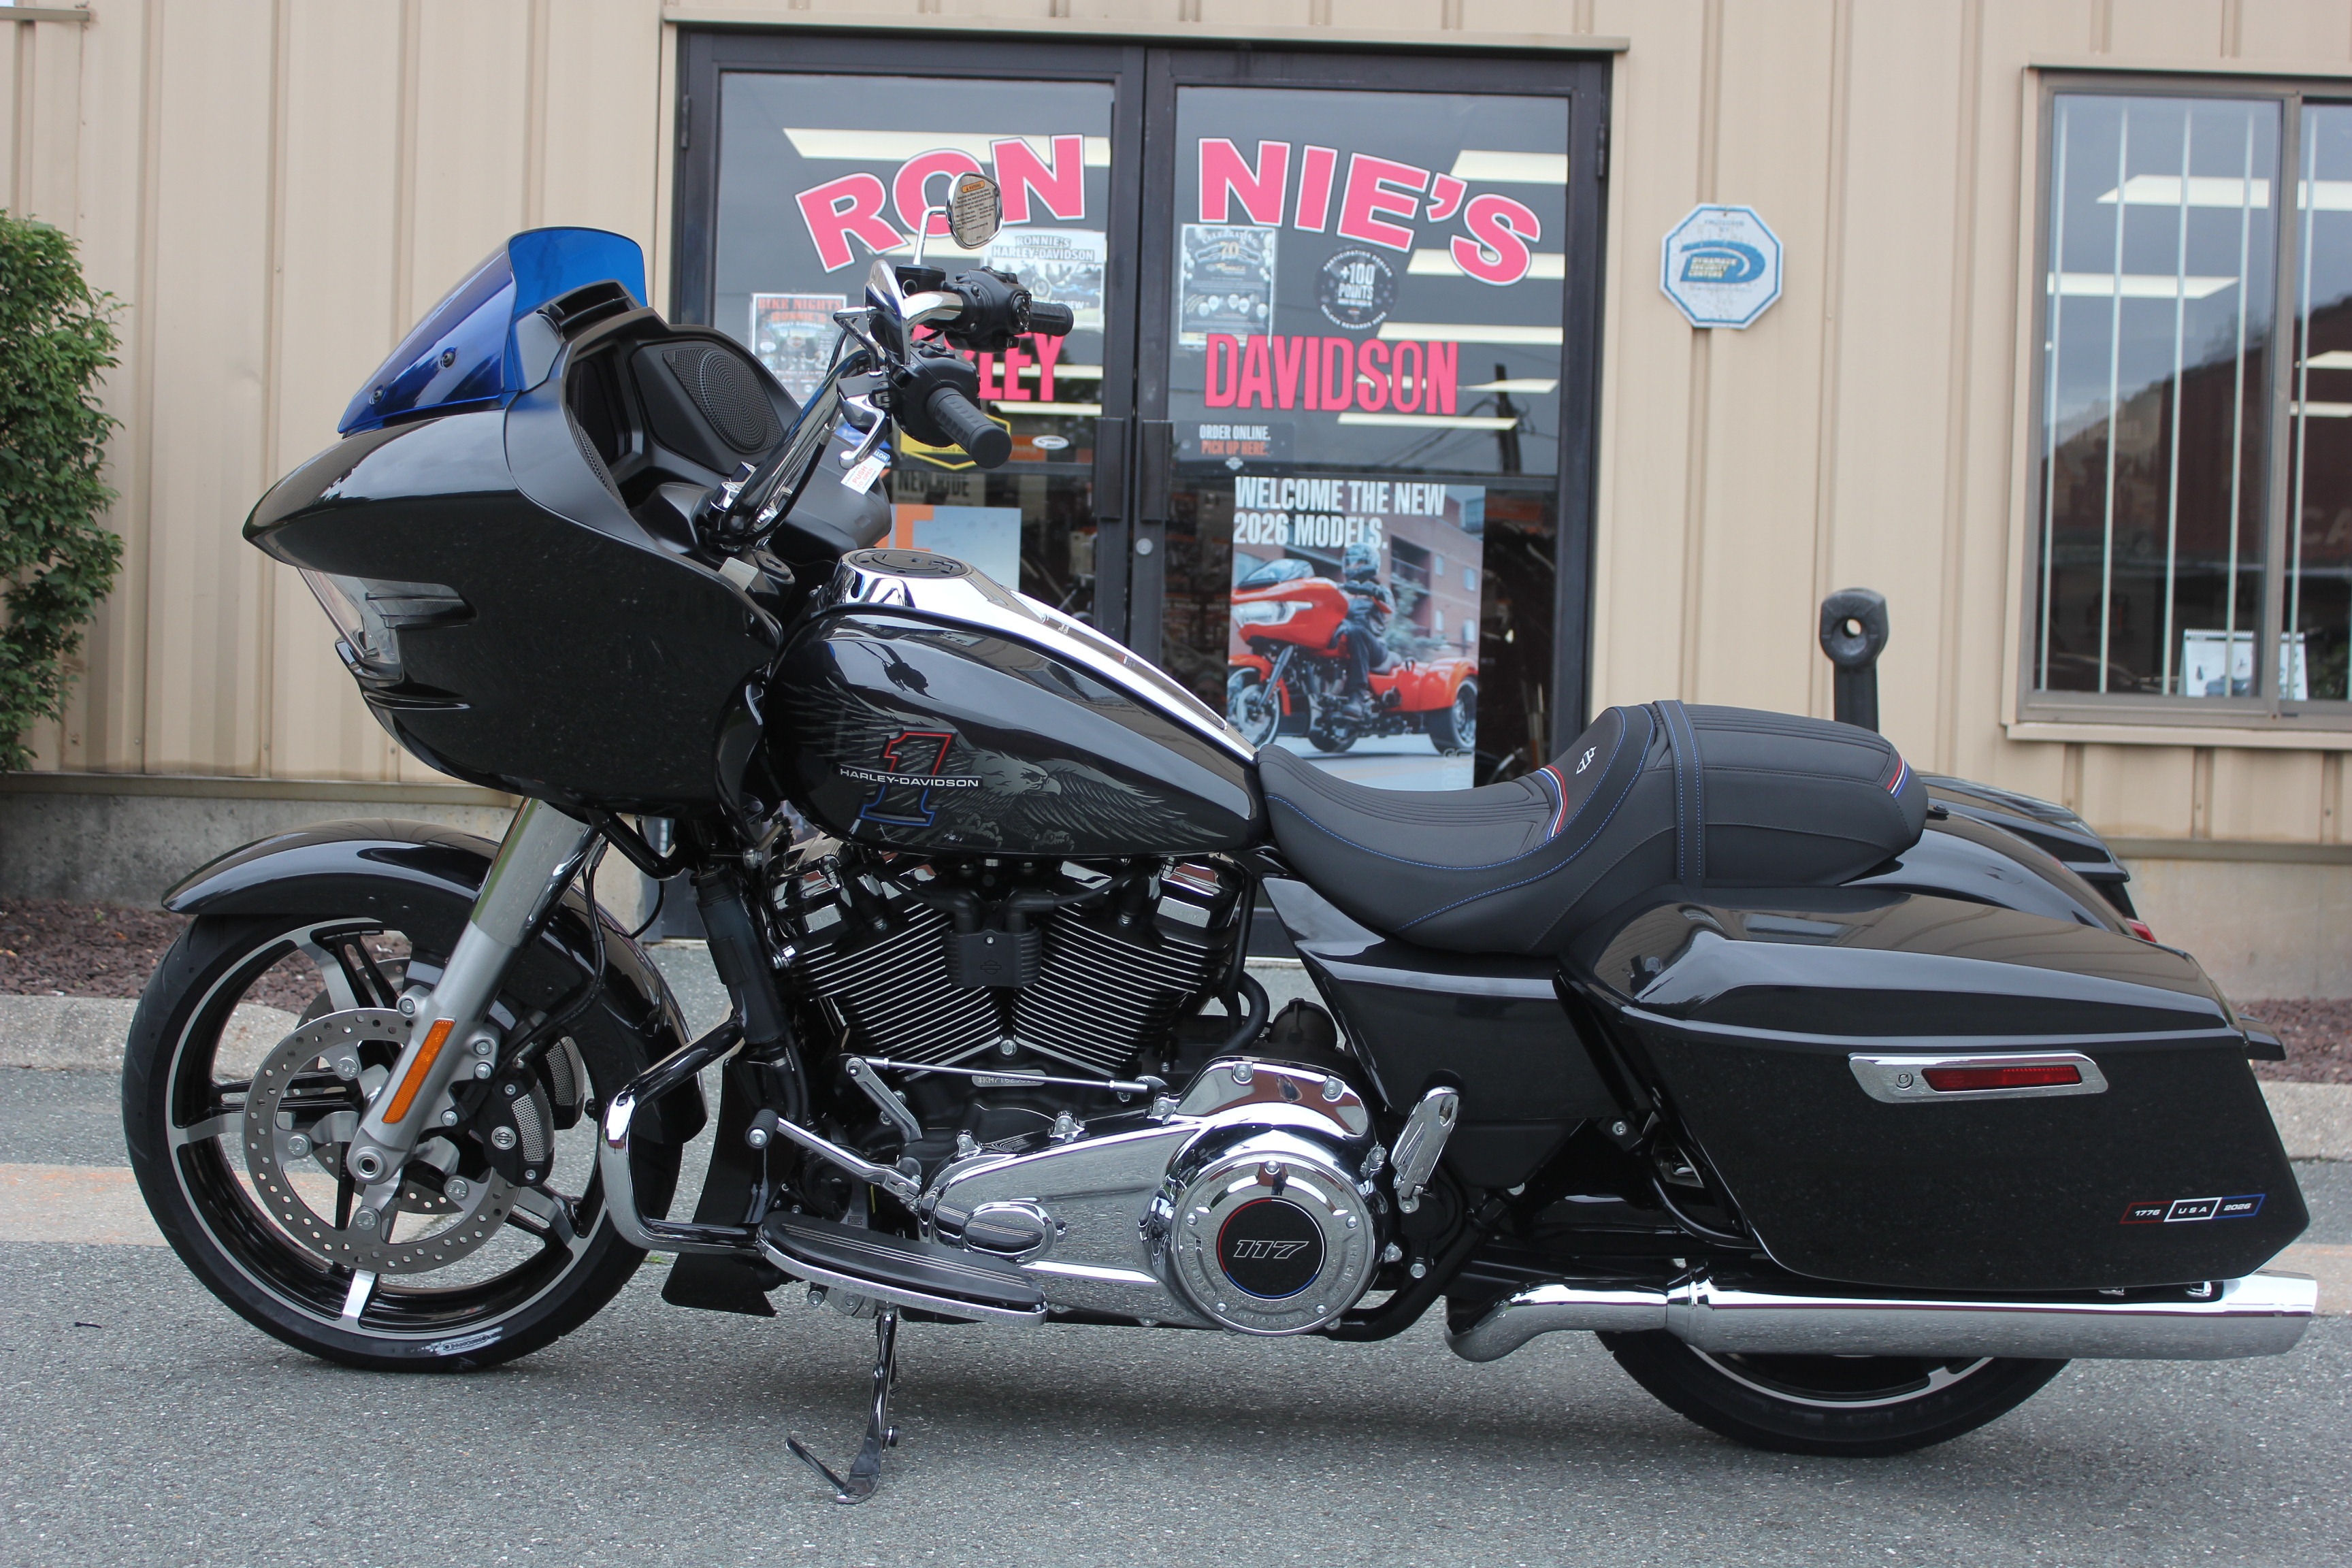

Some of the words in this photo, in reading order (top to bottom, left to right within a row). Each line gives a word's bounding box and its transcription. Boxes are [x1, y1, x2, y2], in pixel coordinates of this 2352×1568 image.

[795, 133, 1085, 273] RON
[1198, 138, 1541, 286] NIE'S
[1015, 235, 1072, 247] RONNIE'S
[992, 246, 1094, 261] HARLEY-DAVIDSON
[1340, 262, 1375, 285] +100
[1338, 282, 1374, 300] POINTS
[758, 298, 789, 309] BIKE
[793, 299, 843, 310] NIGHTS
[1204, 333, 1458, 415] DAVIDSON
[1199, 424, 1232, 440] ORDER
[1232, 425, 1271, 441] ONLINE.
[1201, 440, 1224, 455] PICK
[1226, 440, 1239, 455] UP
[852, 465, 868, 484] PUSH
[1235, 476, 1344, 512] WELCOME
[1348, 480, 1390, 514] THE
[1394, 483, 1447, 517] NEW
[1232, 512, 1290, 545] 2026
[840, 768, 979, 787] HARLEY-DAVIDSON
[2223, 1203, 2252, 1211] 2026
[1233, 1239, 1310, 1260] 117
